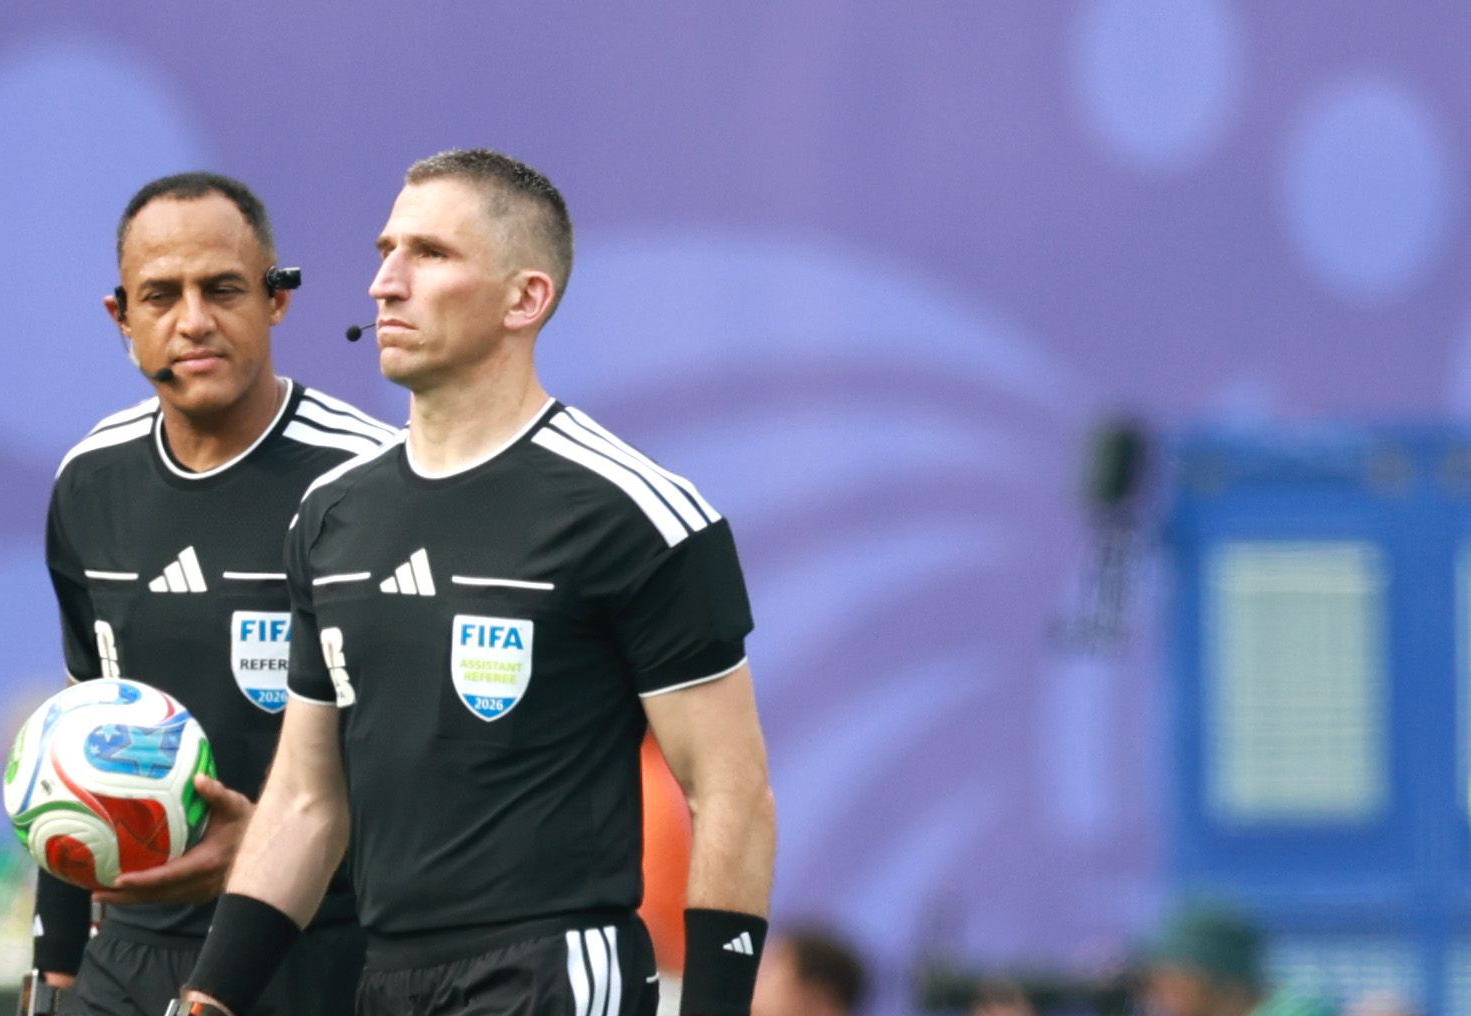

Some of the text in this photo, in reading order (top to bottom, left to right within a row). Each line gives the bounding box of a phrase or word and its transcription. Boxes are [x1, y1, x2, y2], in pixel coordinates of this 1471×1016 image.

[461, 624, 524, 650] FIFA
[240, 659, 288, 670] REFER
[460, 659, 523, 672] ASSISTANT
[464, 671, 517, 684] REFEREE
[474, 698, 504, 711] 2026
